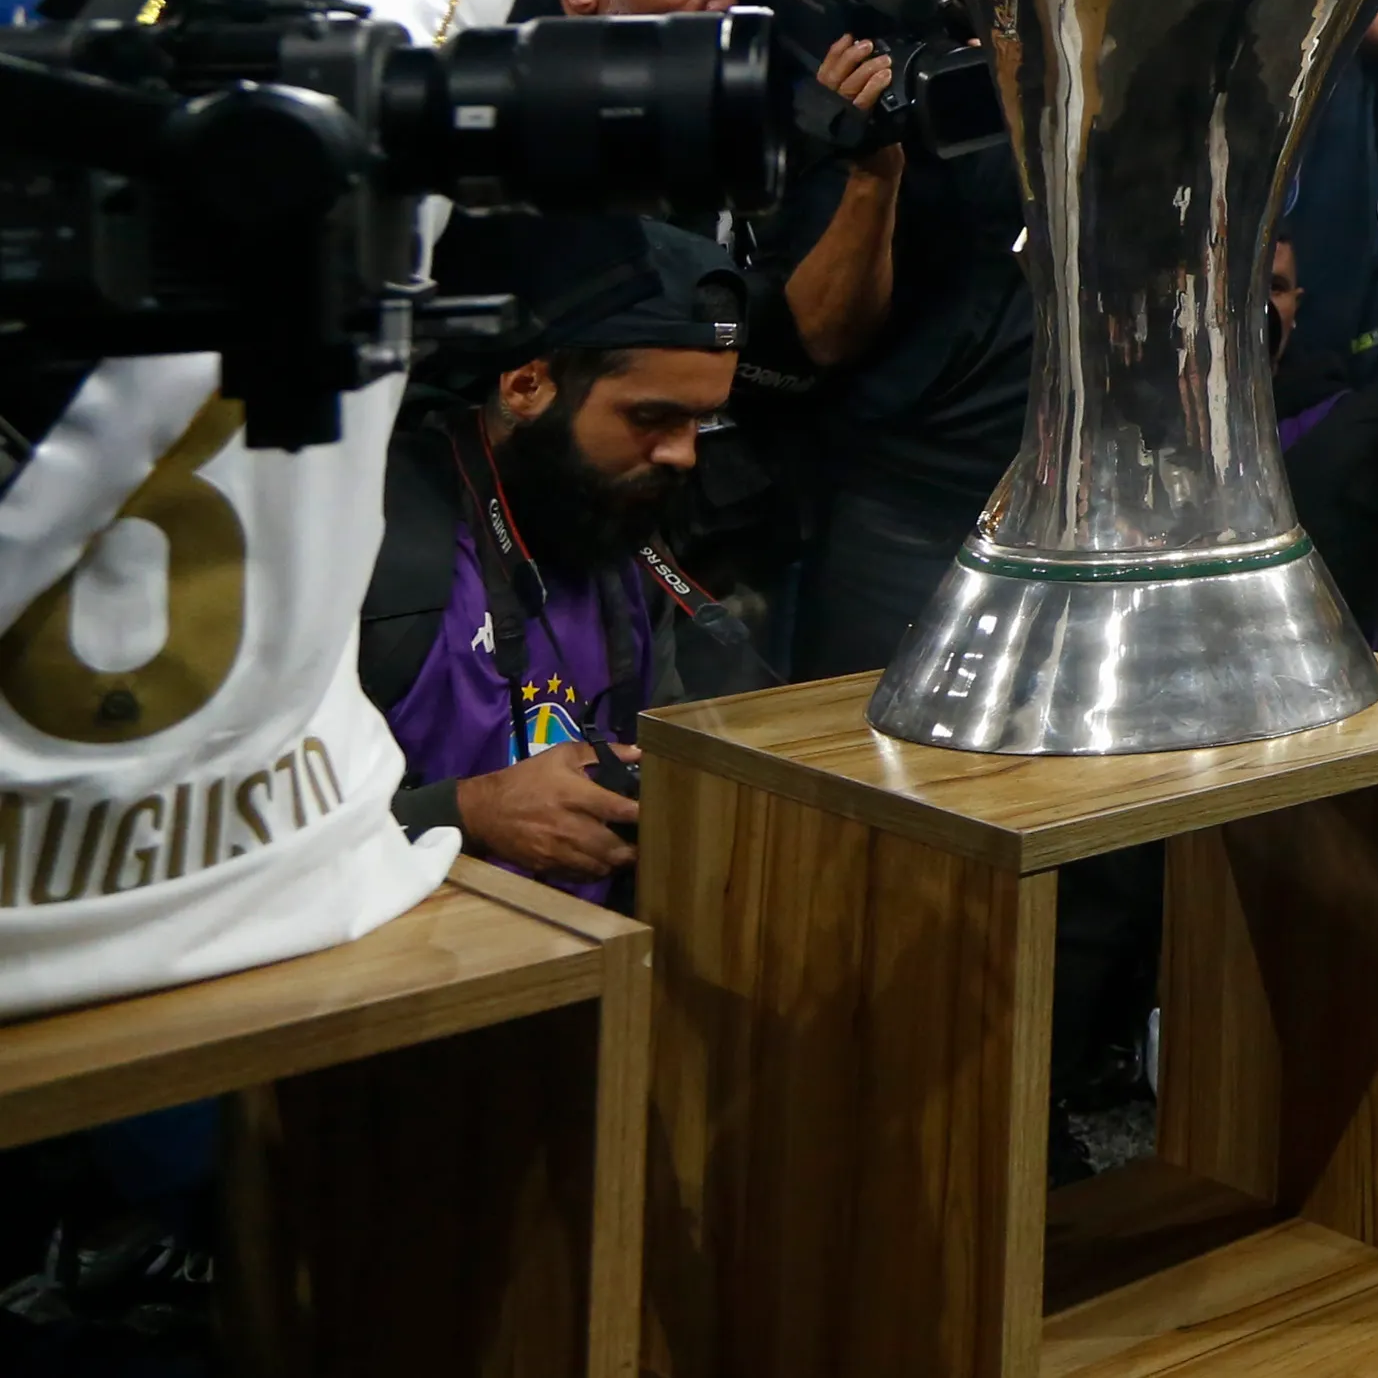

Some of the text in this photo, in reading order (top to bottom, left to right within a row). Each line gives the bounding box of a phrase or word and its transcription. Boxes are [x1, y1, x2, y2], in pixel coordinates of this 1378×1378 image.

[488, 497, 513, 555] Canon
[639, 546, 691, 596] EOS R6
